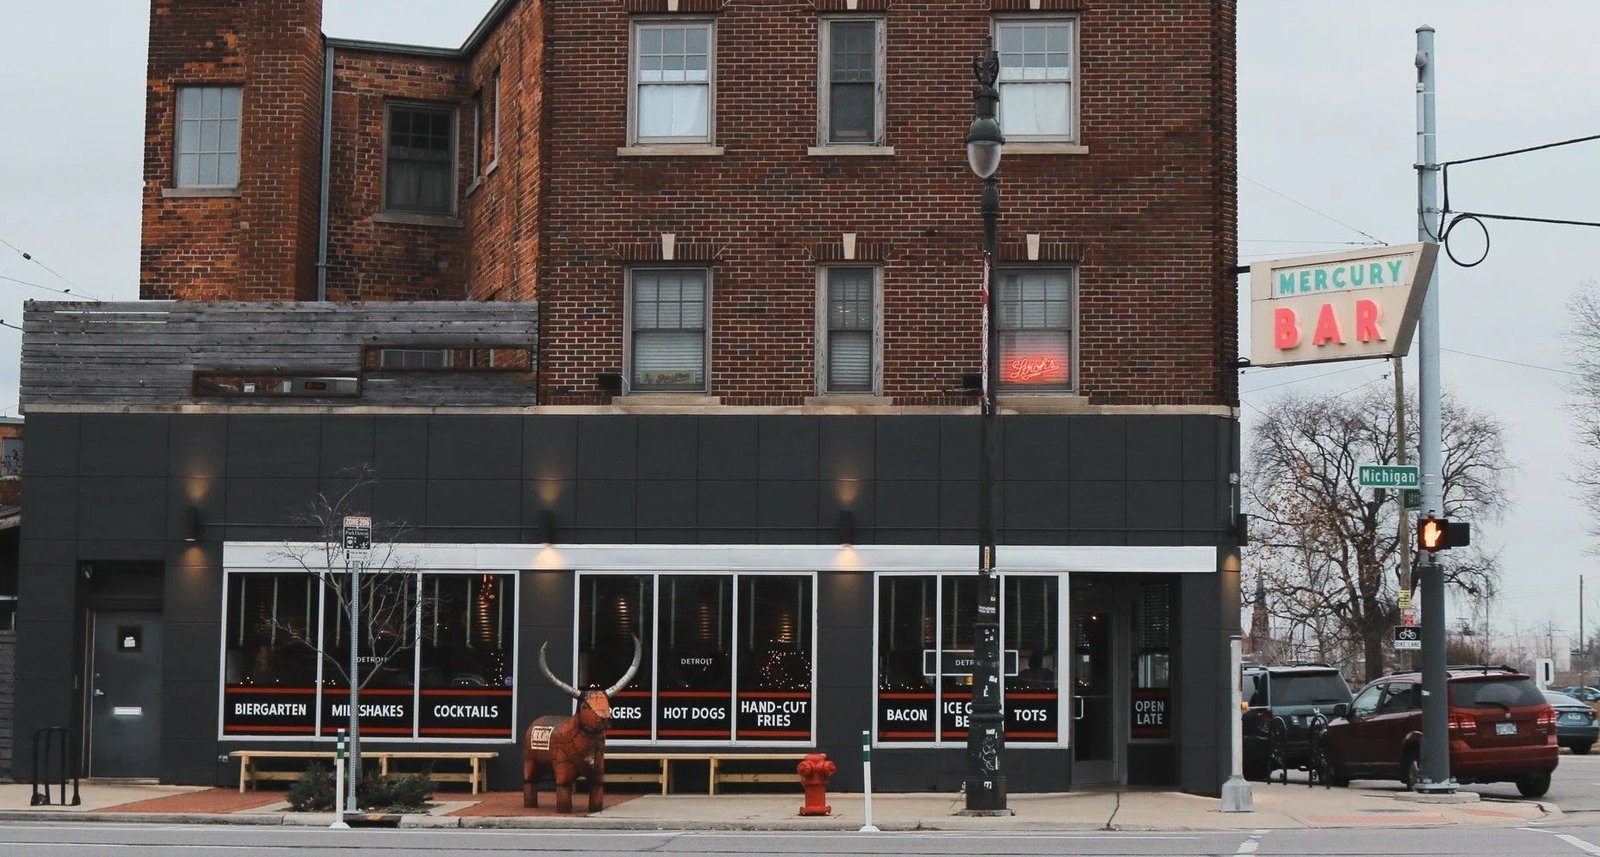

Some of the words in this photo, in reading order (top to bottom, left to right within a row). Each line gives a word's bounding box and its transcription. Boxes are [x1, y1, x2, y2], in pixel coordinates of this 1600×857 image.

[1279, 260, 1402, 295] MERCURY
[1274, 300, 1386, 349] BAR
[1010, 357, 1059, 380] Stroh's
[1362, 469, 1416, 485] Michigan
[235, 703, 307, 716] BIERGARTEN
[331, 704, 404, 717] MILSHAKES
[434, 705, 499, 718] COCKTAILS
[741, 701, 807, 713] HAND-CUT
[944, 702, 962, 714] ICE
[1135, 701, 1164, 712] OPEN
[664, 707, 688, 719] HOT
[691, 707, 726, 720] DOGS
[886, 709, 928, 721] BACON
[1014, 709, 1047, 721] TOTS
[1137, 713, 1163, 725] LATE
[757, 714, 791, 727] FRIES
